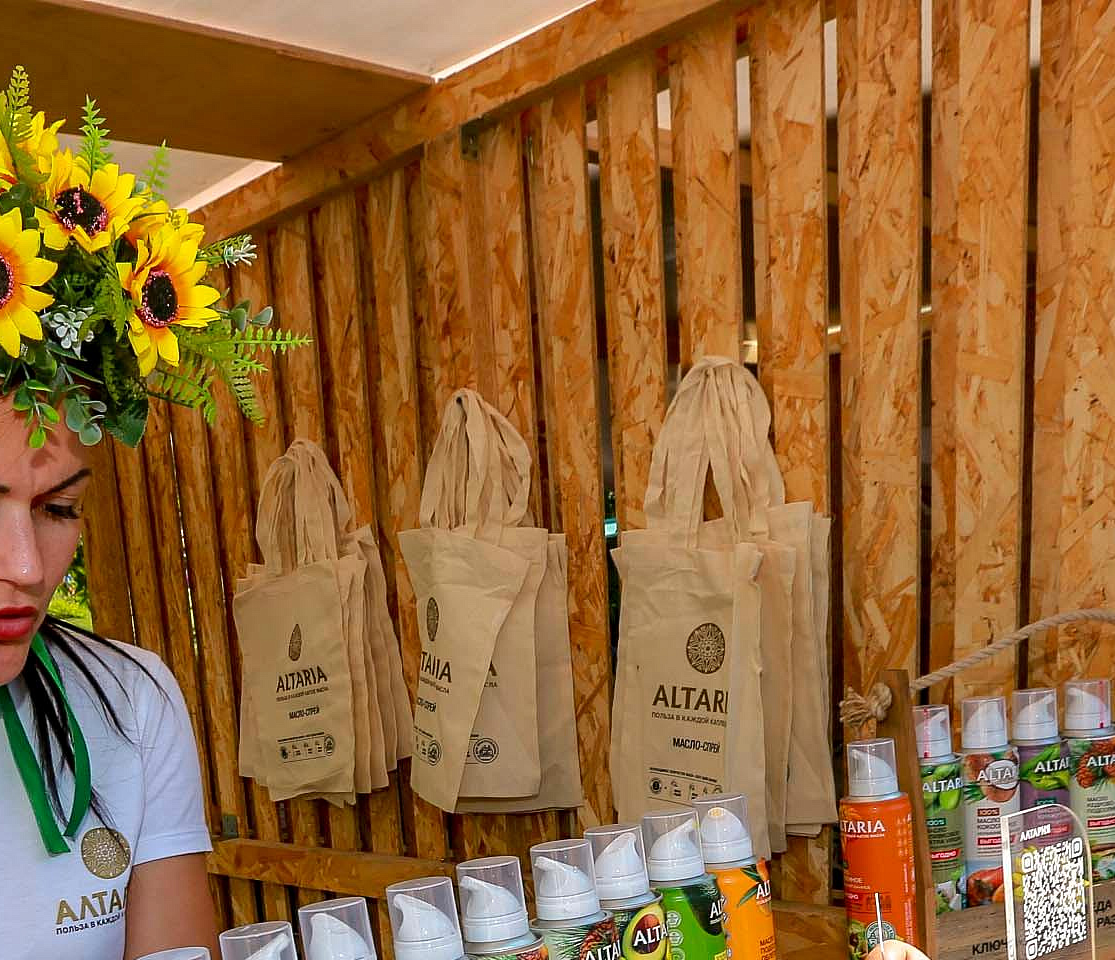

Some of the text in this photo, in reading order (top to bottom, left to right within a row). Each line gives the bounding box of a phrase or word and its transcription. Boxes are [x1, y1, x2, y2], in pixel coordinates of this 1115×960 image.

[276, 665, 327, 693] ALTARIA
[651, 711, 675, 721] ПОЛЬЗА
[55, 886, 127, 925] АЛТА
[56, 923, 89, 936] ПОЛЬЗА
[90, 920, 96, 929] В
[633, 923, 668, 947] ALTA
